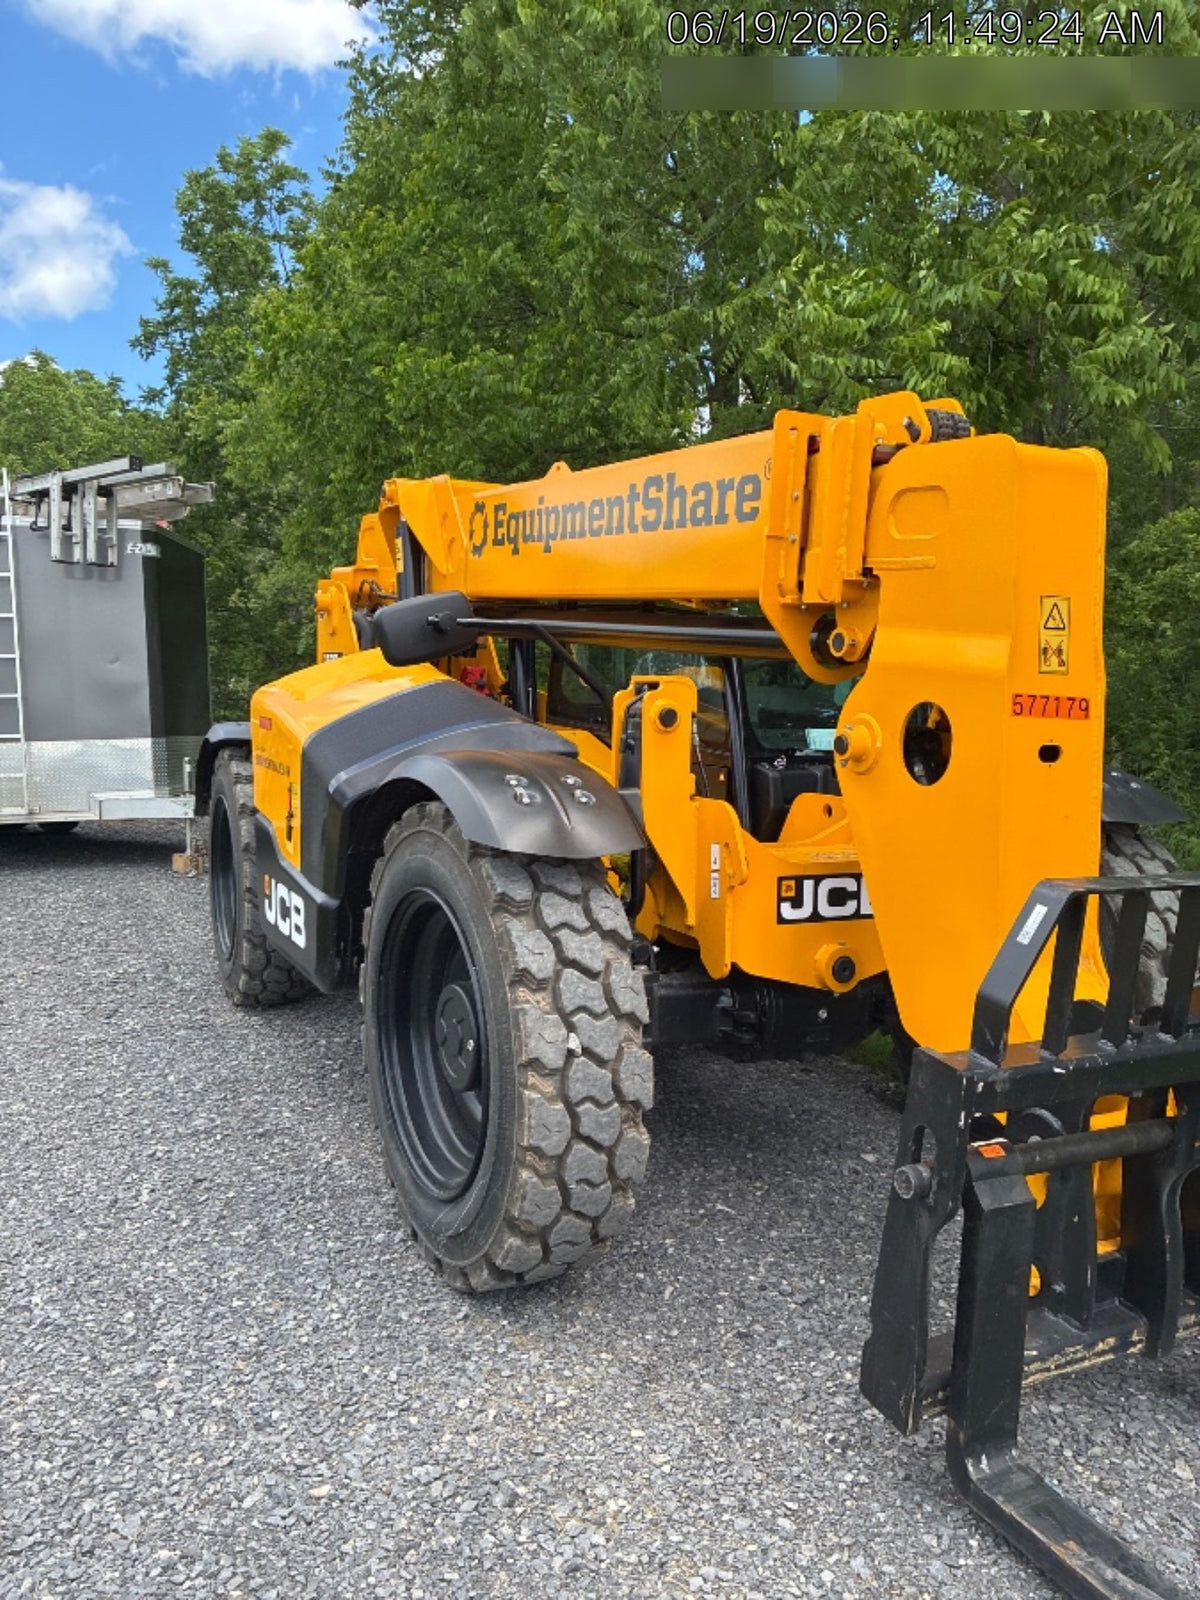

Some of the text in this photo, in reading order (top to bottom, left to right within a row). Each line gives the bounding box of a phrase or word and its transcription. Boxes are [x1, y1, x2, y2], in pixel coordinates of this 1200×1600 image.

[492, 472, 762, 556] EquipmentShare
[1012, 693, 1090, 720] 577179
[264, 877, 307, 951] JCB
